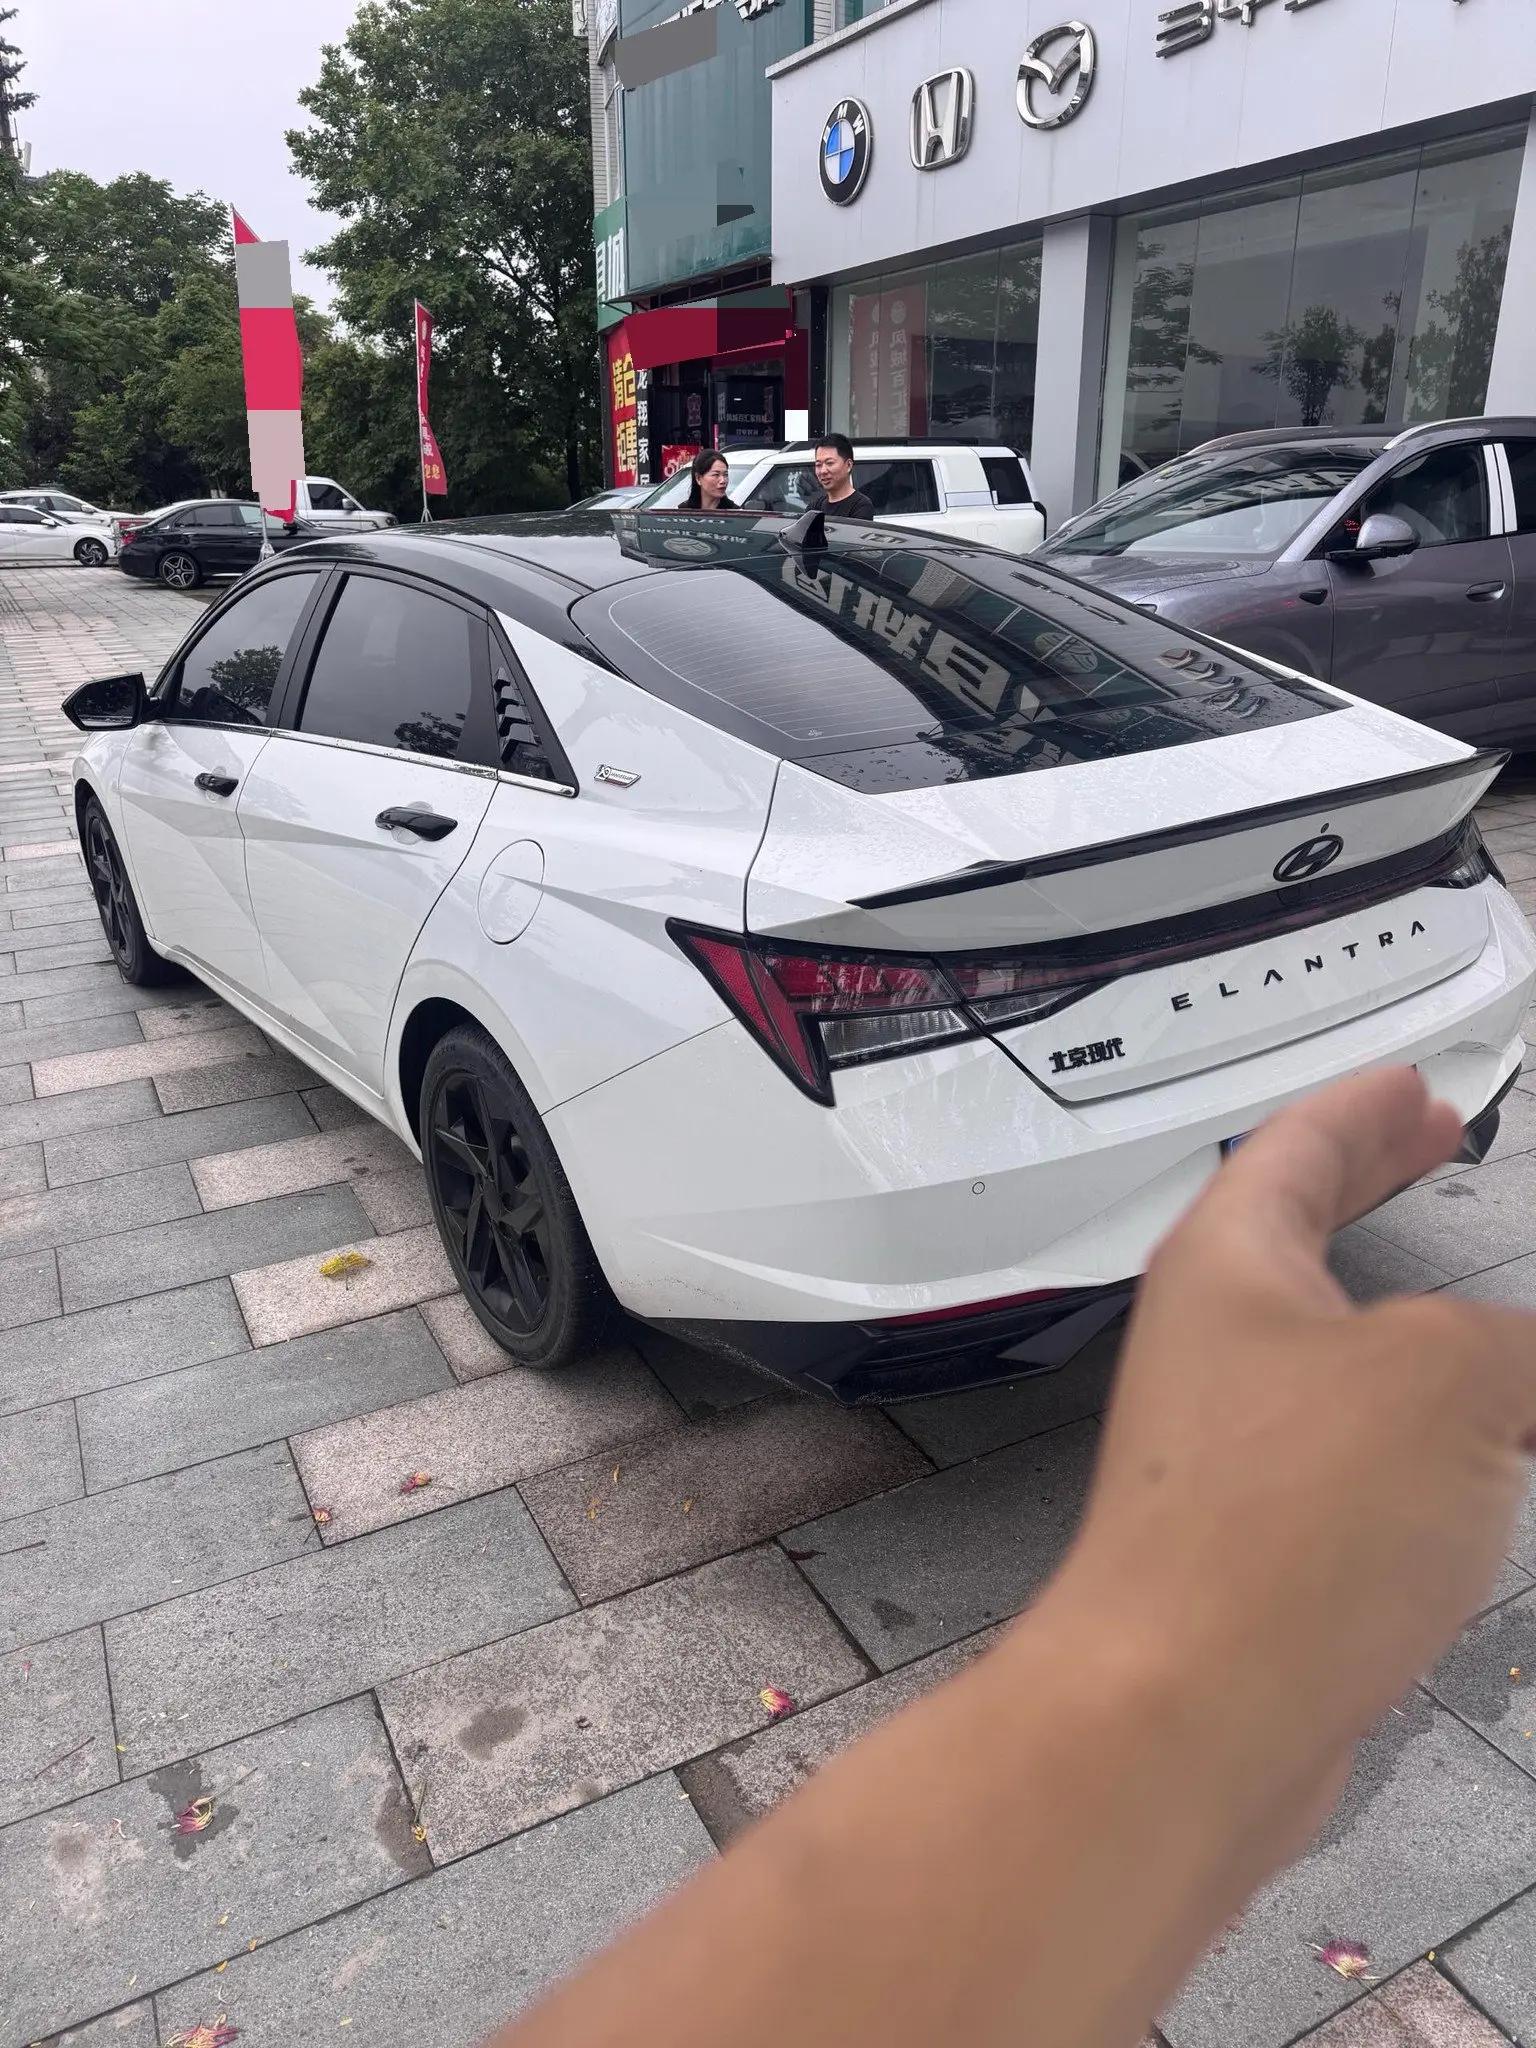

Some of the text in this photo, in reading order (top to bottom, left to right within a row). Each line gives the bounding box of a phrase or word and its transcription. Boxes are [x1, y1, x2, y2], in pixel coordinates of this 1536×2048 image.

[1170, 920, 1427, 1011] ELANTRA
[1048, 1036, 1126, 1074] 北京现代
